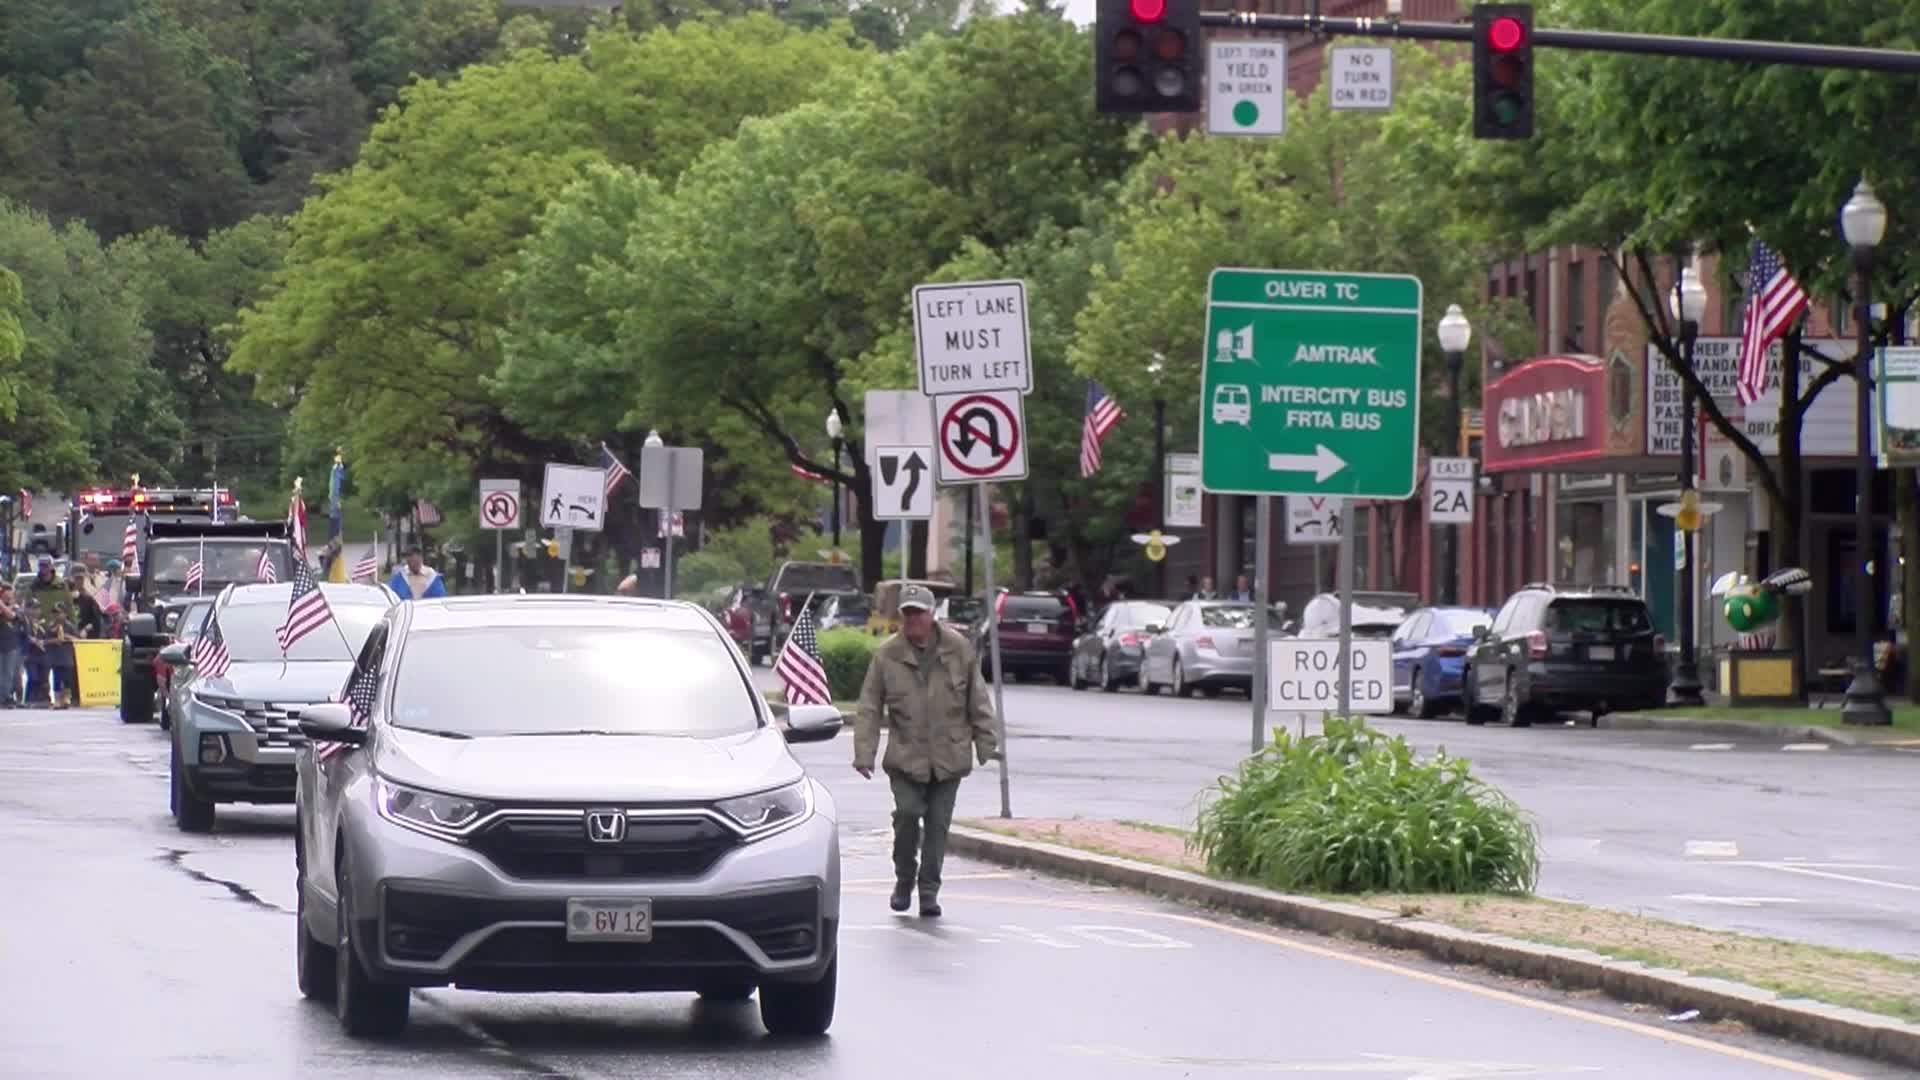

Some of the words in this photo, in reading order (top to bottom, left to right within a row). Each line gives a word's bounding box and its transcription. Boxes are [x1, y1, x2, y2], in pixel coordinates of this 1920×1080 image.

[1217, 47, 1242, 59] LEFT
[1248, 47, 1276, 58] TURN
[1350, 53, 1374, 66] NO
[1226, 62, 1269, 79] YIELD
[1344, 71, 1381, 84] TURN
[1218, 83, 1233, 94] ON
[1239, 83, 1272, 95] GREEN
[1335, 88, 1355, 101] ON
[1360, 88, 1388, 101] RED
[1264, 280, 1326, 299] OLVER
[1334, 282, 1360, 300] TC
[926, 299, 965, 319] LEFT
[975, 296, 1017, 316] LANE
[945, 328, 1001, 351] MUST
[1292, 344, 1378, 365] AMTRAK
[929, 363, 973, 382] TURN
[983, 360, 1021, 380] LEFT
[1260, 384, 1361, 406] INTERCITY
[1367, 389, 1407, 408] BUS
[1286, 410, 1335, 429] FRTA
[1340, 412, 1382, 431] BUS
[1436, 461, 1467, 474] EAST
[1432, 489, 1469, 512] 2A
[595, 910, 619, 932] GV
[623, 910, 647, 933] 12
